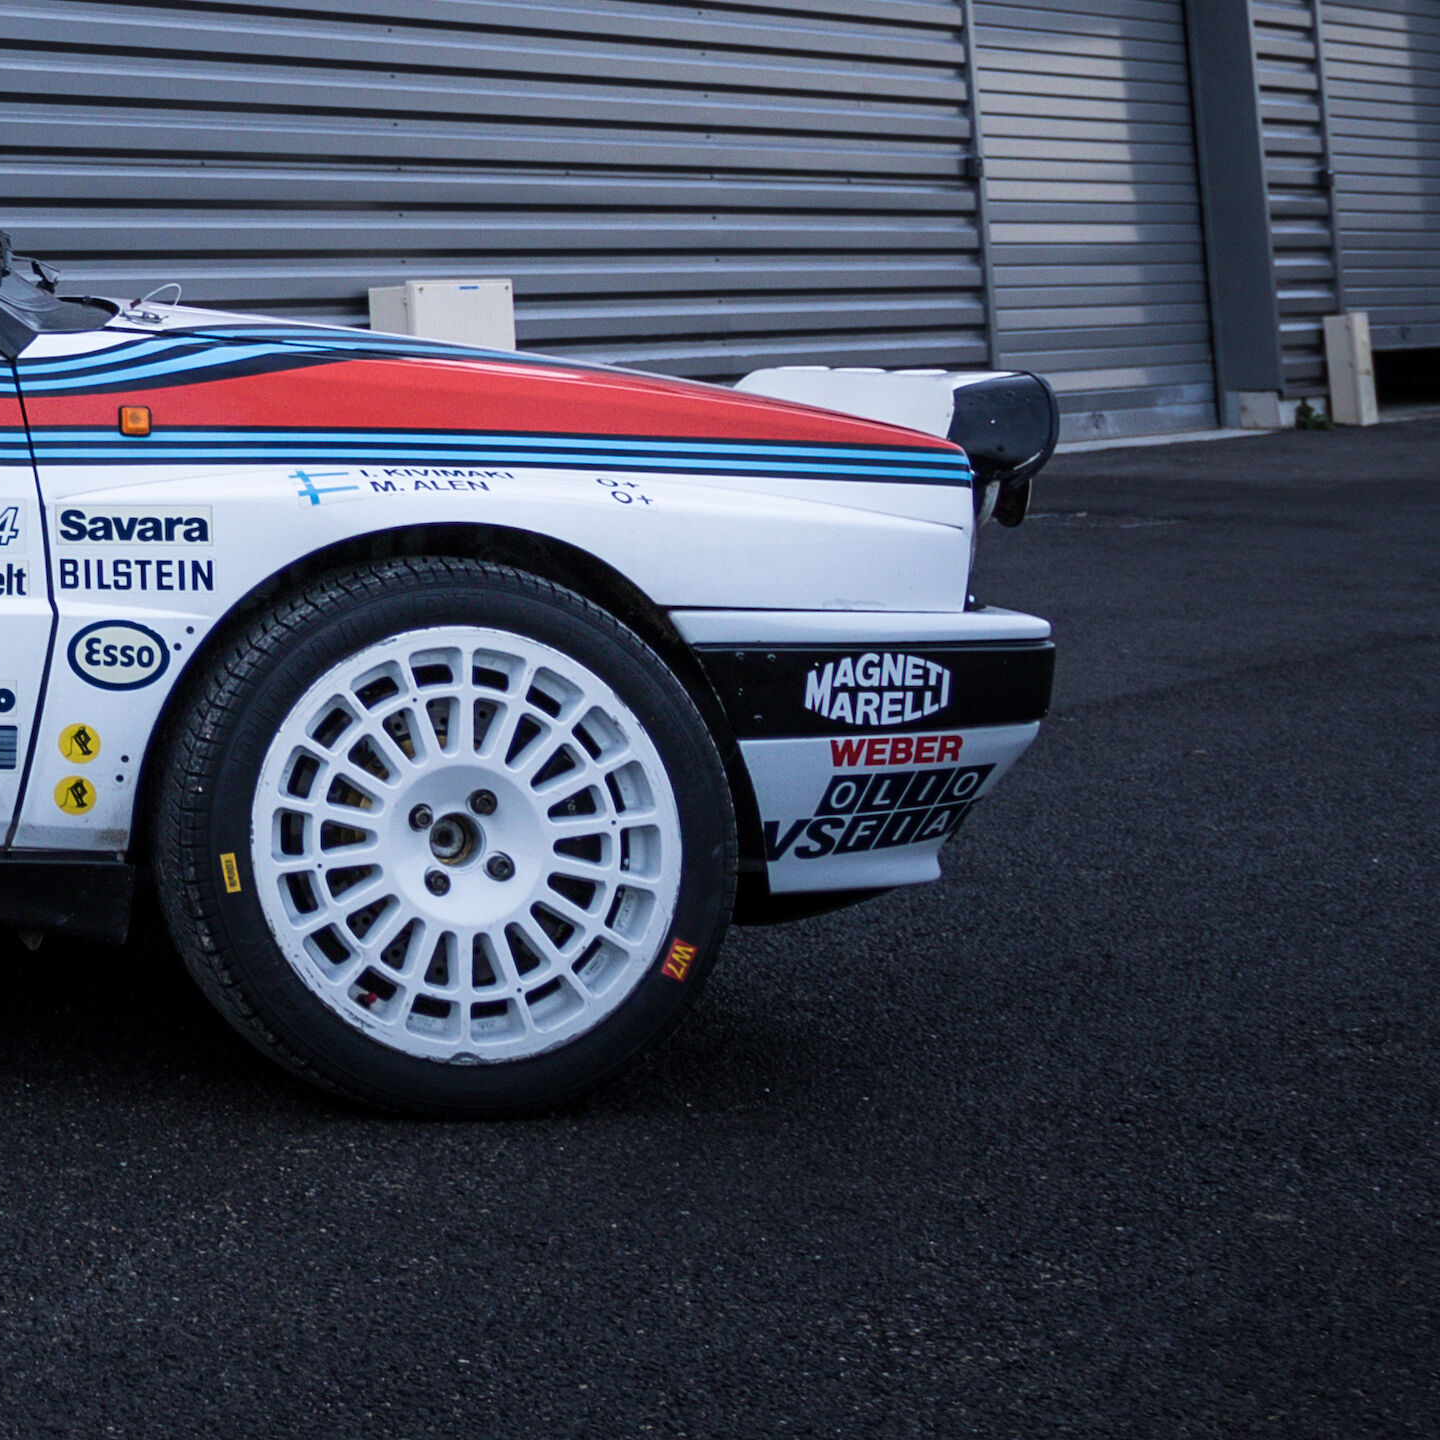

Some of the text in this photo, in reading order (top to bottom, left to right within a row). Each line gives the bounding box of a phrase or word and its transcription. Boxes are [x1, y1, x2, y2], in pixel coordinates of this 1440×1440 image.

[370, 480, 406, 492] M.
[413, 480, 491, 492] ALEN
[59, 509, 209, 542] Savara
[59, 558, 214, 591] BILSTEIN
[804, 652, 951, 718] MAGNETI
[829, 734, 964, 767] WEBER
[829, 770, 980, 809] OLIO
